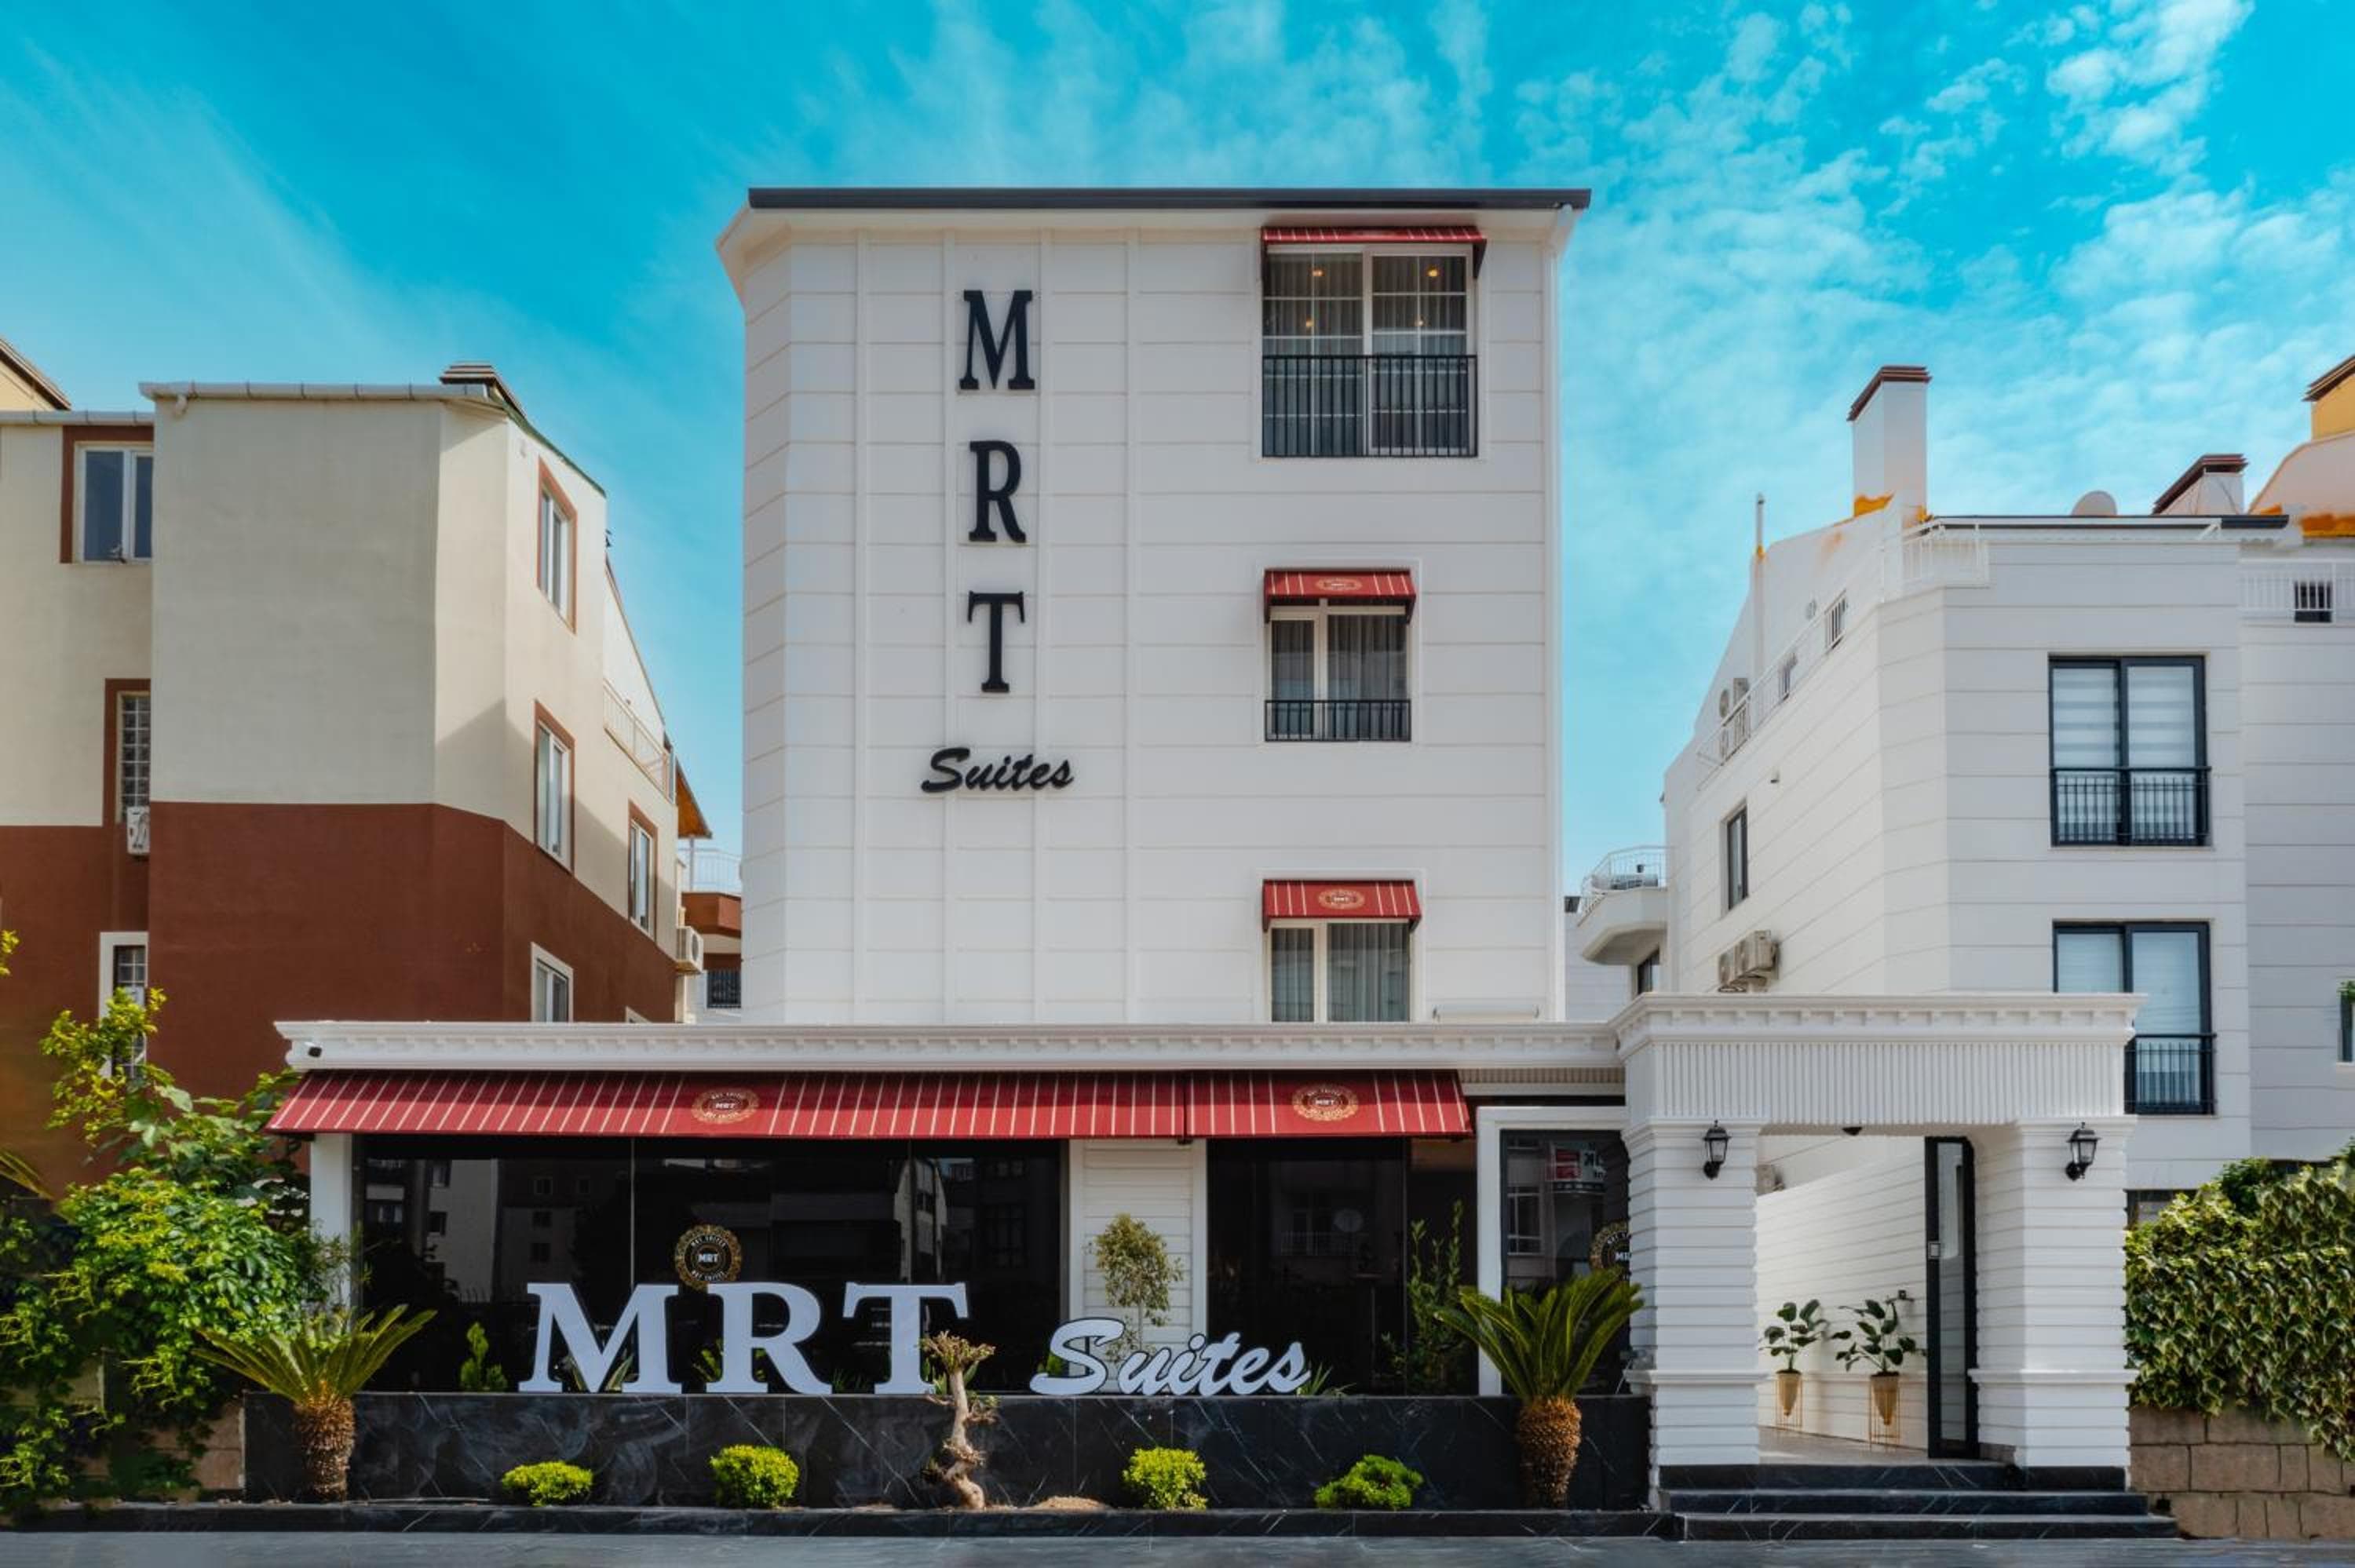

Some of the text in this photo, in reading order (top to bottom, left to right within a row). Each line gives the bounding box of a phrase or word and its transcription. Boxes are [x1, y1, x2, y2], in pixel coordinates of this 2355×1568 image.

[958, 290, 1035, 693] MRT
[921, 746, 1075, 793] Suites
[698, 1253, 718, 1263] MRT
[518, 1282, 1312, 1397] MRT Suites
